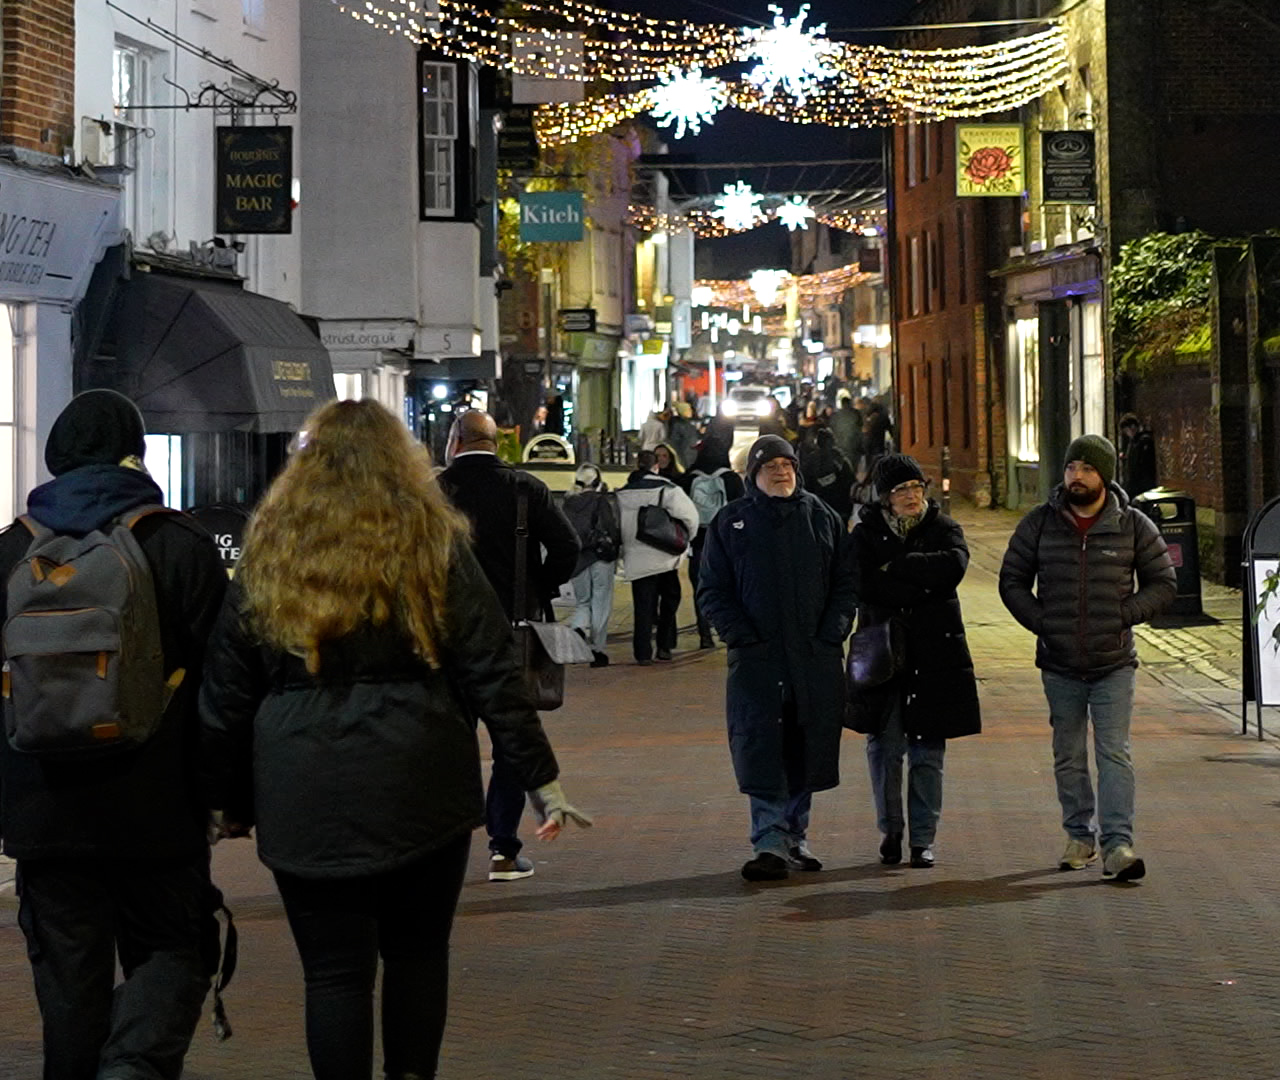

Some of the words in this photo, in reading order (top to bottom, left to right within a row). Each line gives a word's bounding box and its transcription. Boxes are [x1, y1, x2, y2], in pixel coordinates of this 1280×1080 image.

[226, 173, 283, 188] MAGIC
[236, 196, 272, 211] BAR
[523, 204, 579, 224] Kitch
